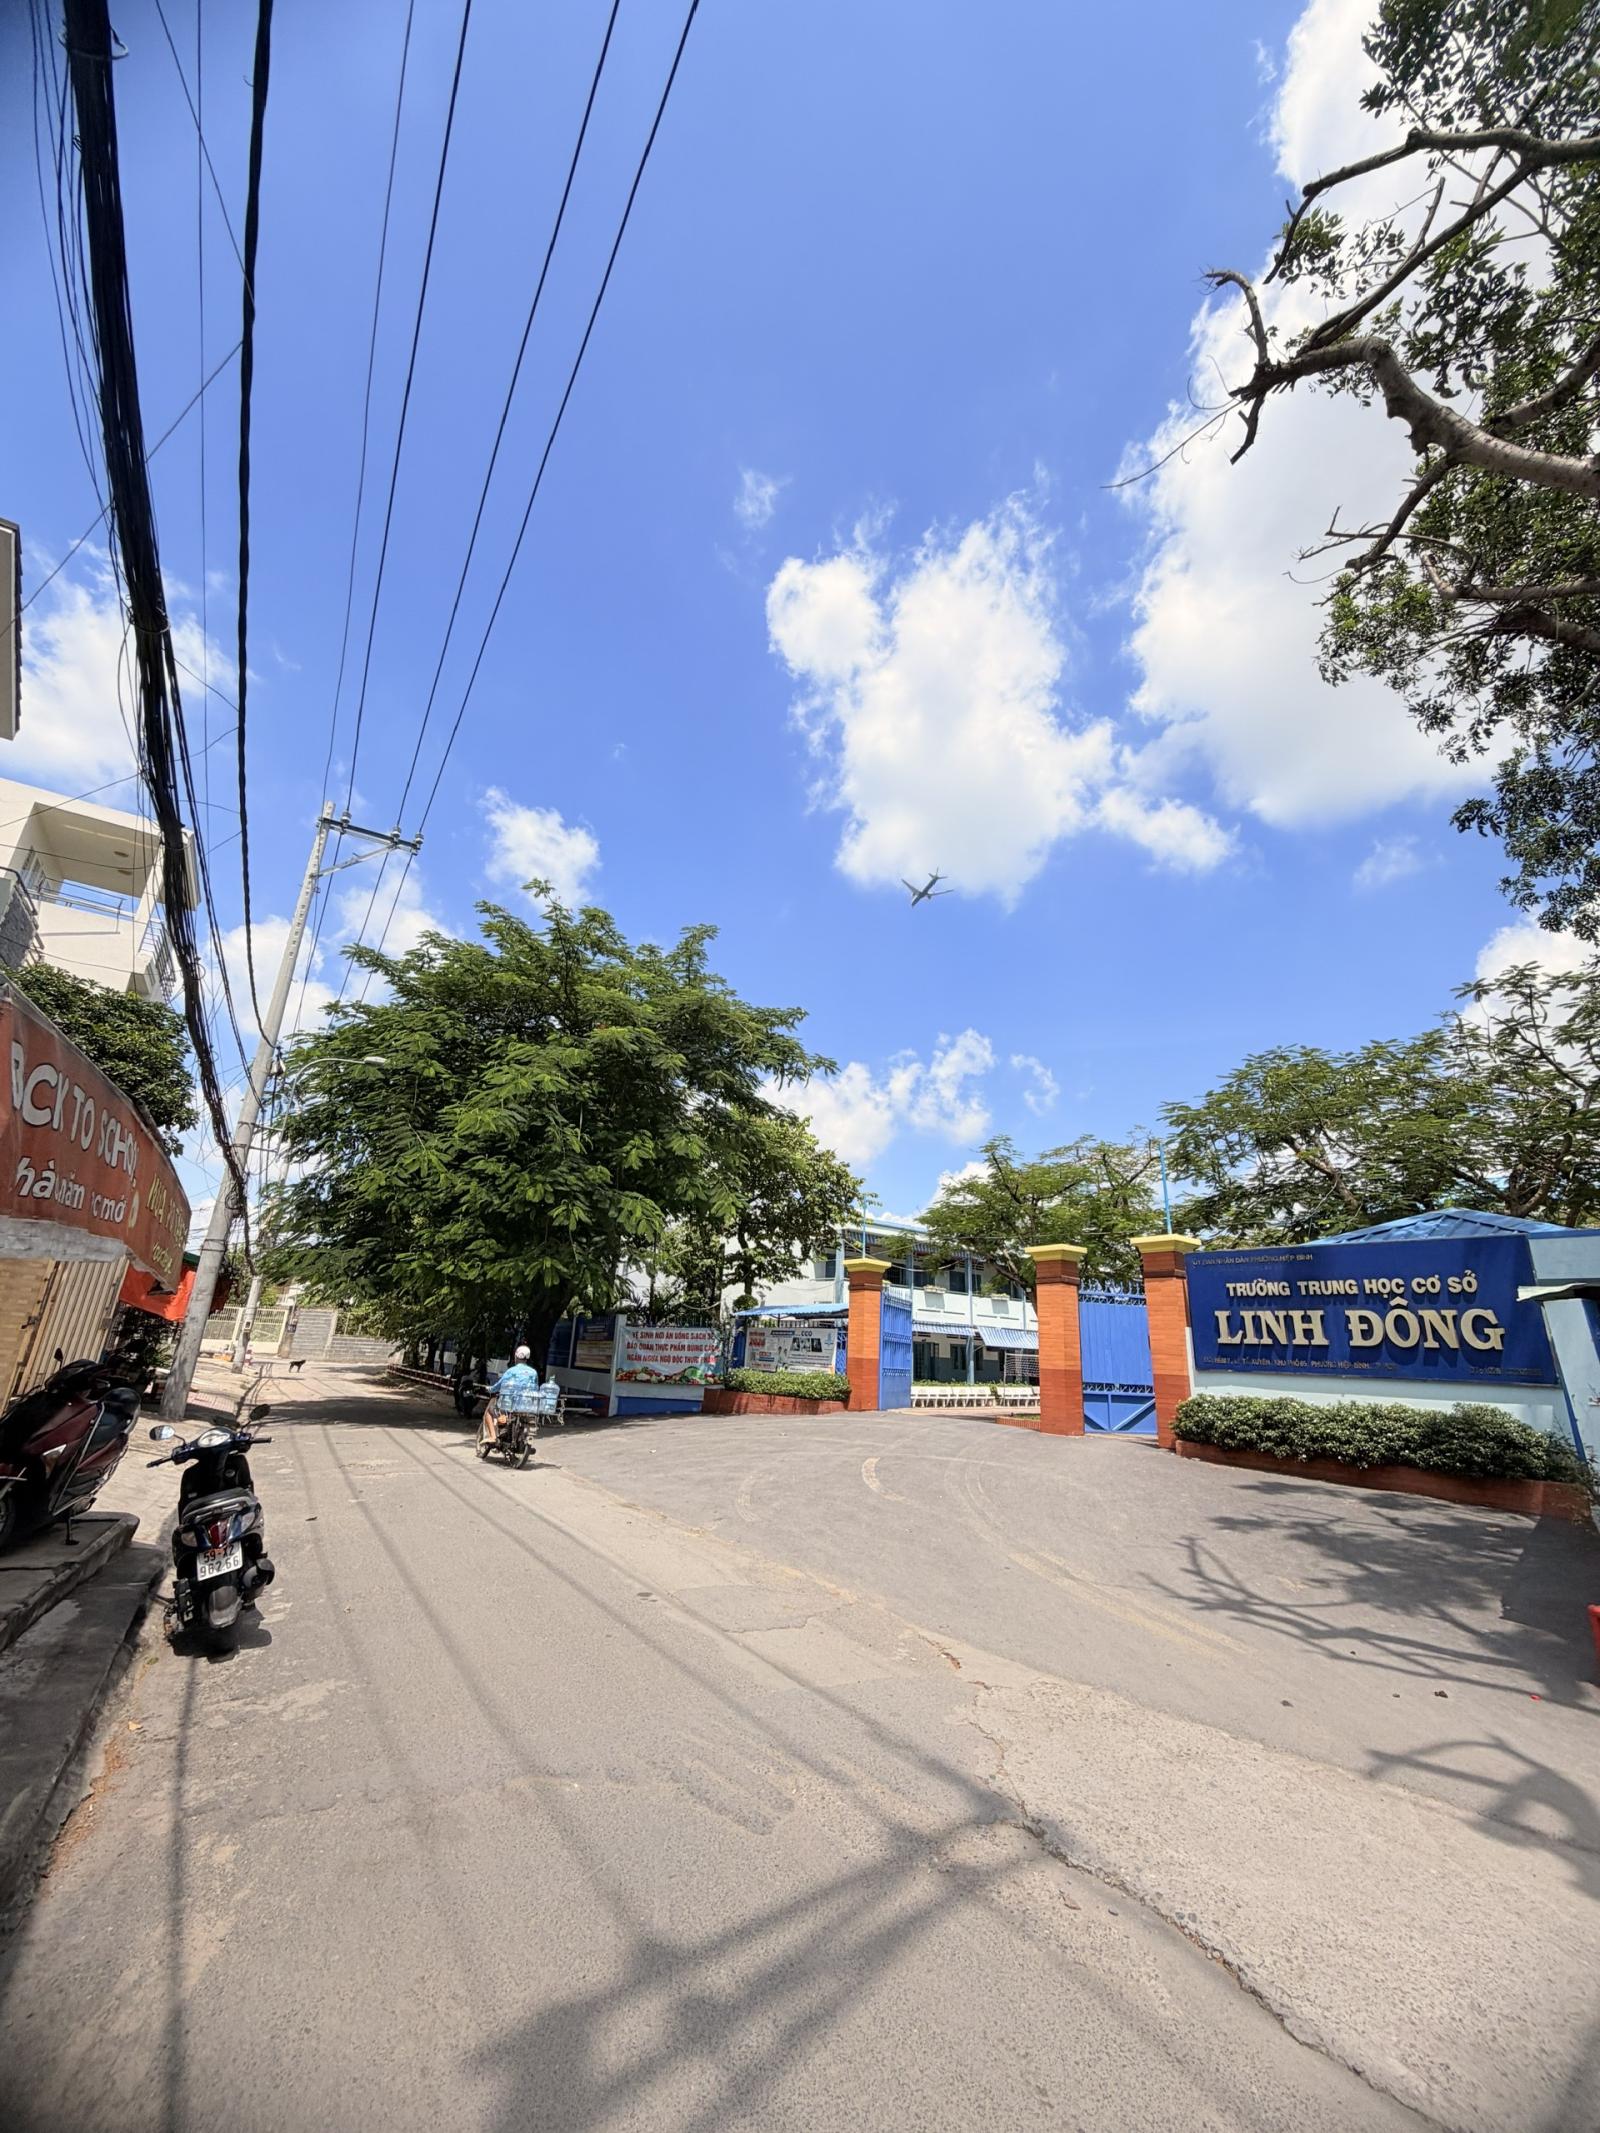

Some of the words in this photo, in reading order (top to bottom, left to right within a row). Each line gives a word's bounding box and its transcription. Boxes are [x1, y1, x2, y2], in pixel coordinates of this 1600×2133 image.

[71, 1082, 95, 1152] TO
[1226, 1278, 1290, 1297] TRƯỜNG
[1297, 1279, 1359, 1296] TRUNG
[1363, 1277, 1405, 1298] HỌC
[1411, 1274, 1441, 1294] CƠ
[1447, 1269, 1479, 1294] SỞ
[1214, 1309, 1329, 1346] LINH
[1345, 1297, 1505, 1350] ĐÔNG
